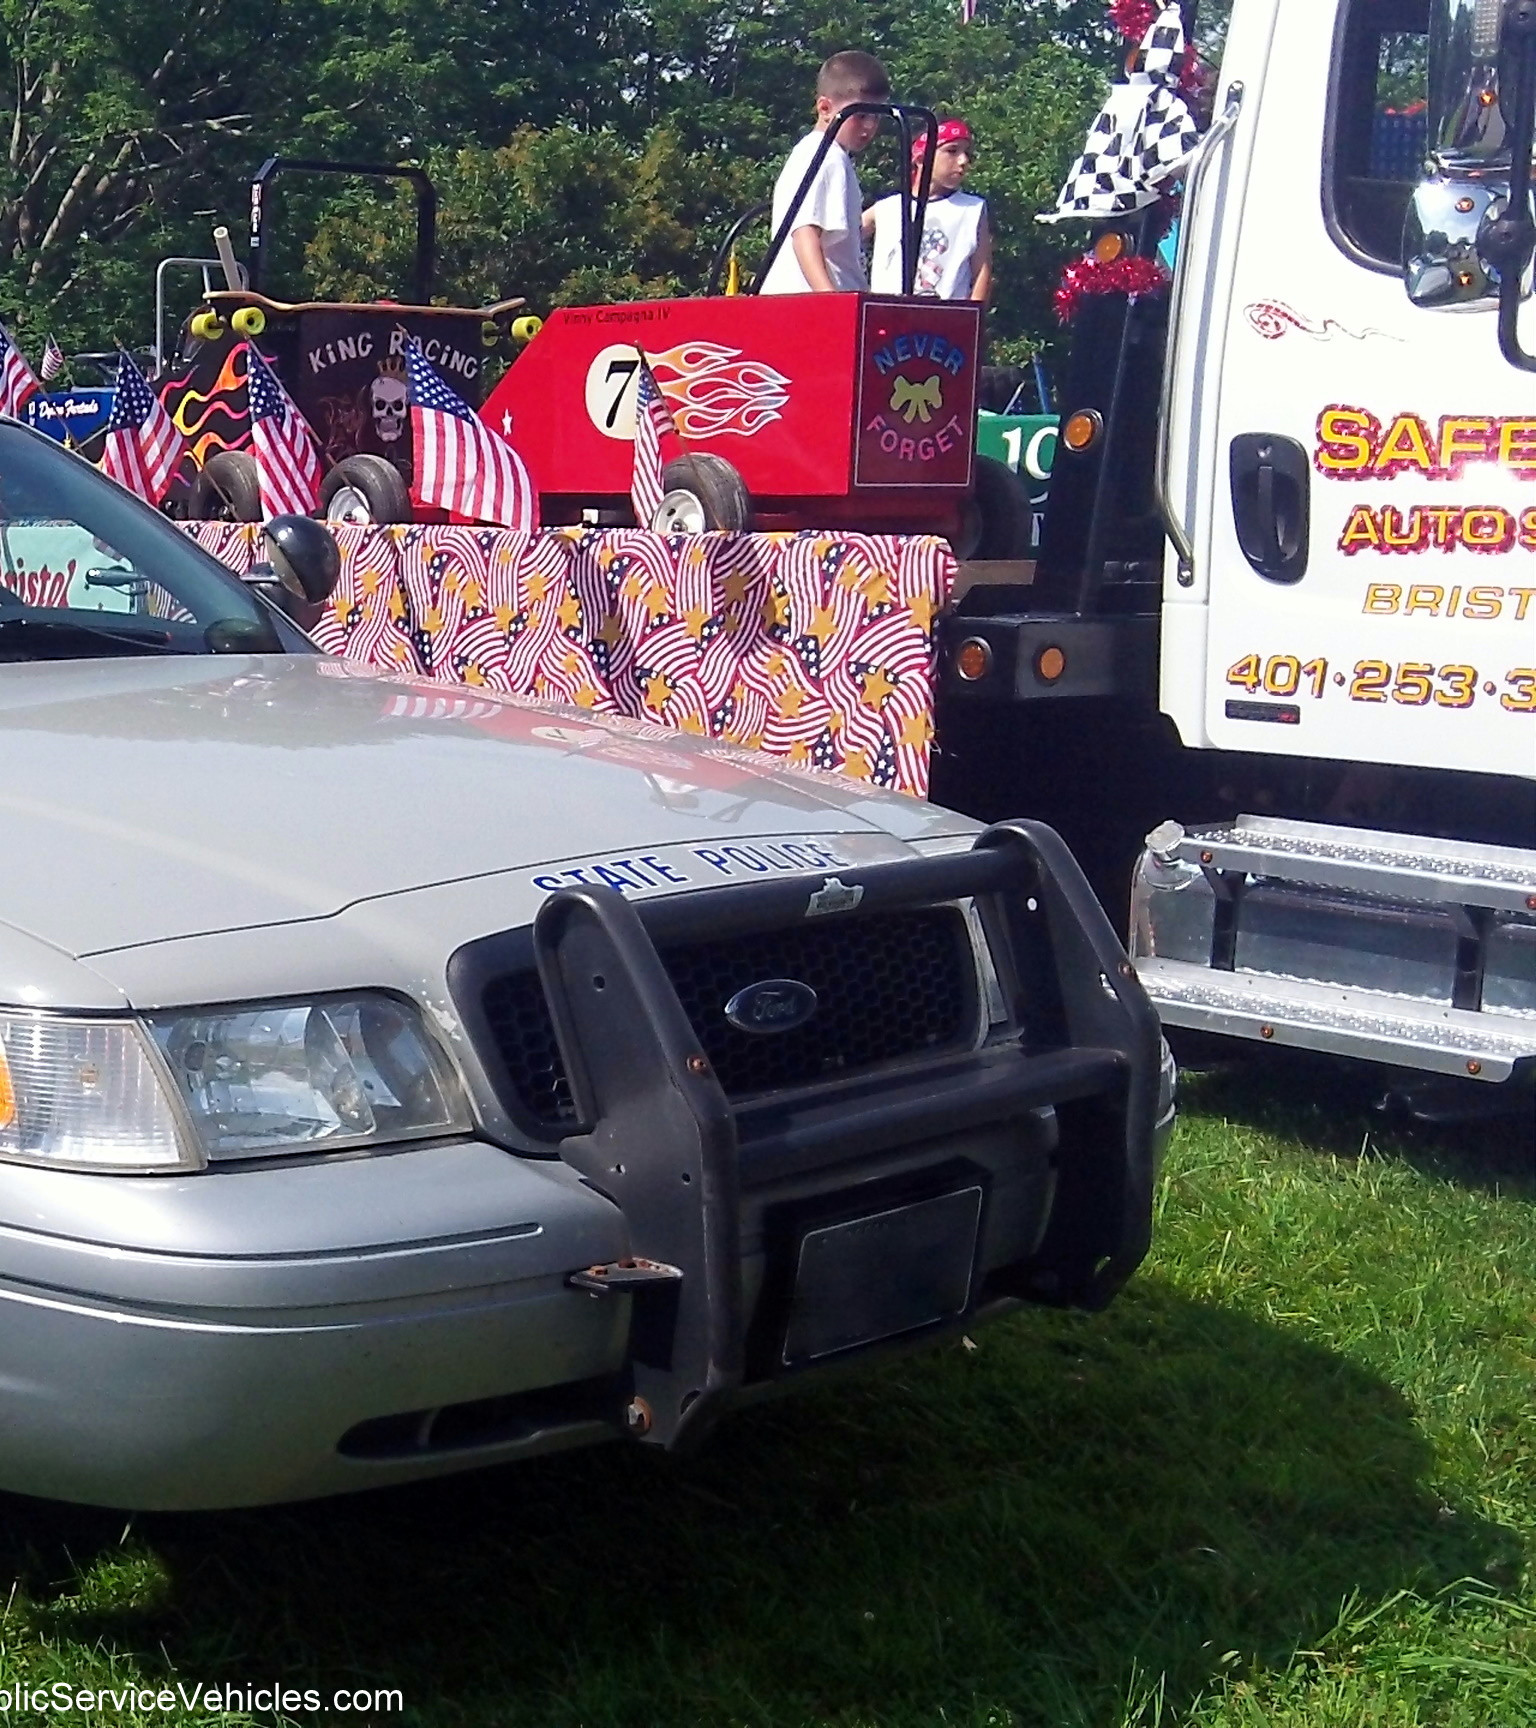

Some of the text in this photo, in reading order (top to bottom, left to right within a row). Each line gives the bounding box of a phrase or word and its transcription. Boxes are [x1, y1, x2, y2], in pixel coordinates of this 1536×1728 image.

[873, 332, 965, 375] NEVER
[605, 360, 639, 428] 7
[866, 415, 964, 461] FORGET
[1338, 504, 1515, 556] AUTO
[693, 842, 850, 876] POLICE
